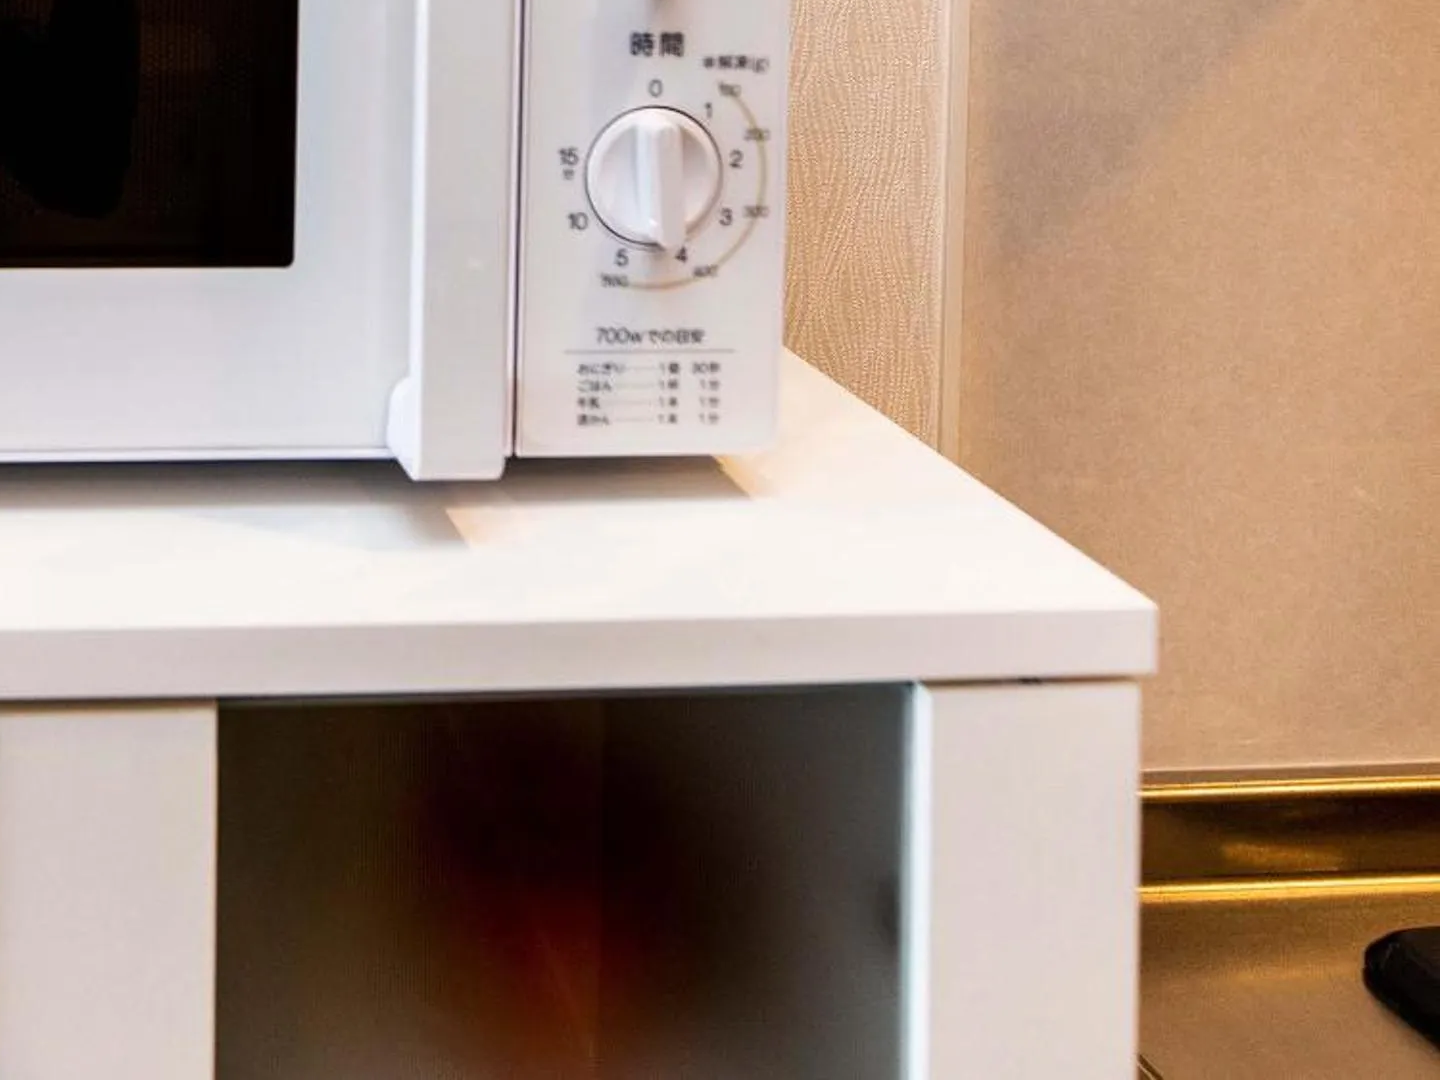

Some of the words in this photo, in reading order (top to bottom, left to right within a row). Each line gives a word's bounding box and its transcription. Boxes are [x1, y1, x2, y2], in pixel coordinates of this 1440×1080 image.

[629, 31, 685, 58] 時間
[648, 79, 663, 98] 0
[704, 102, 714, 120] 1
[558, 146, 580, 167] 15
[729, 149, 744, 169] 2
[567, 212, 589, 231] 10
[719, 207, 733, 226] 3
[614, 249, 630, 268] 5
[674, 245, 688, 264] 4
